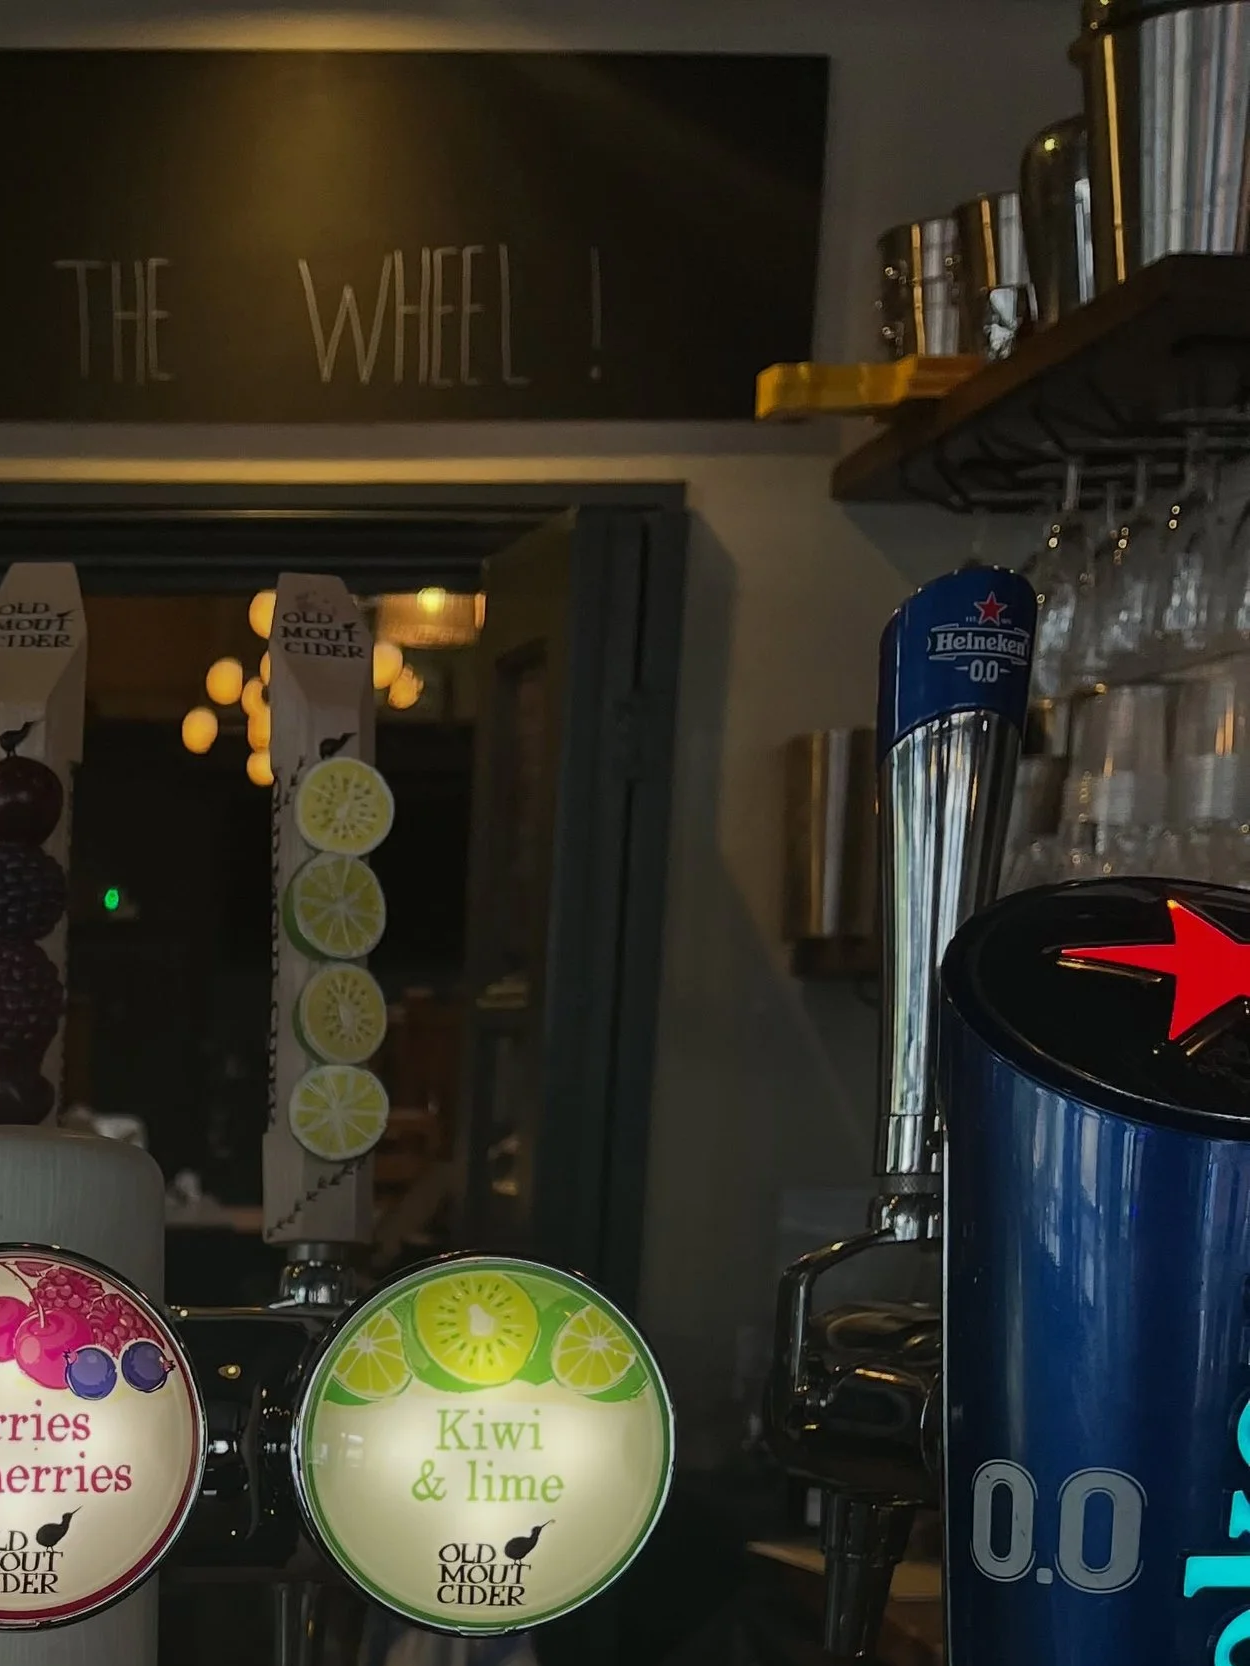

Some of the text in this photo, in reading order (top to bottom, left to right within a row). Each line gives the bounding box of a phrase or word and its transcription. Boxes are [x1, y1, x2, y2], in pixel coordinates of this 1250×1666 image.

[53, 256, 172, 387] THE
[298, 244, 531, 389] WHEEL
[282, 611, 333, 623] OLD
[278, 626, 359, 642] MOUT
[935, 632, 1025, 657] Heineken
[284, 642, 364, 658] CIDER
[970, 659, 999, 683] 0.0
[435, 1408, 544, 1450] Kiwi
[411, 1459, 565, 1502] & lime
[969, 1458, 1148, 1593] 0.0
[438, 1542, 496, 1564] OLD
[437, 1563, 532, 1585] MOUT
[436, 1584, 526, 1606] CIDER
